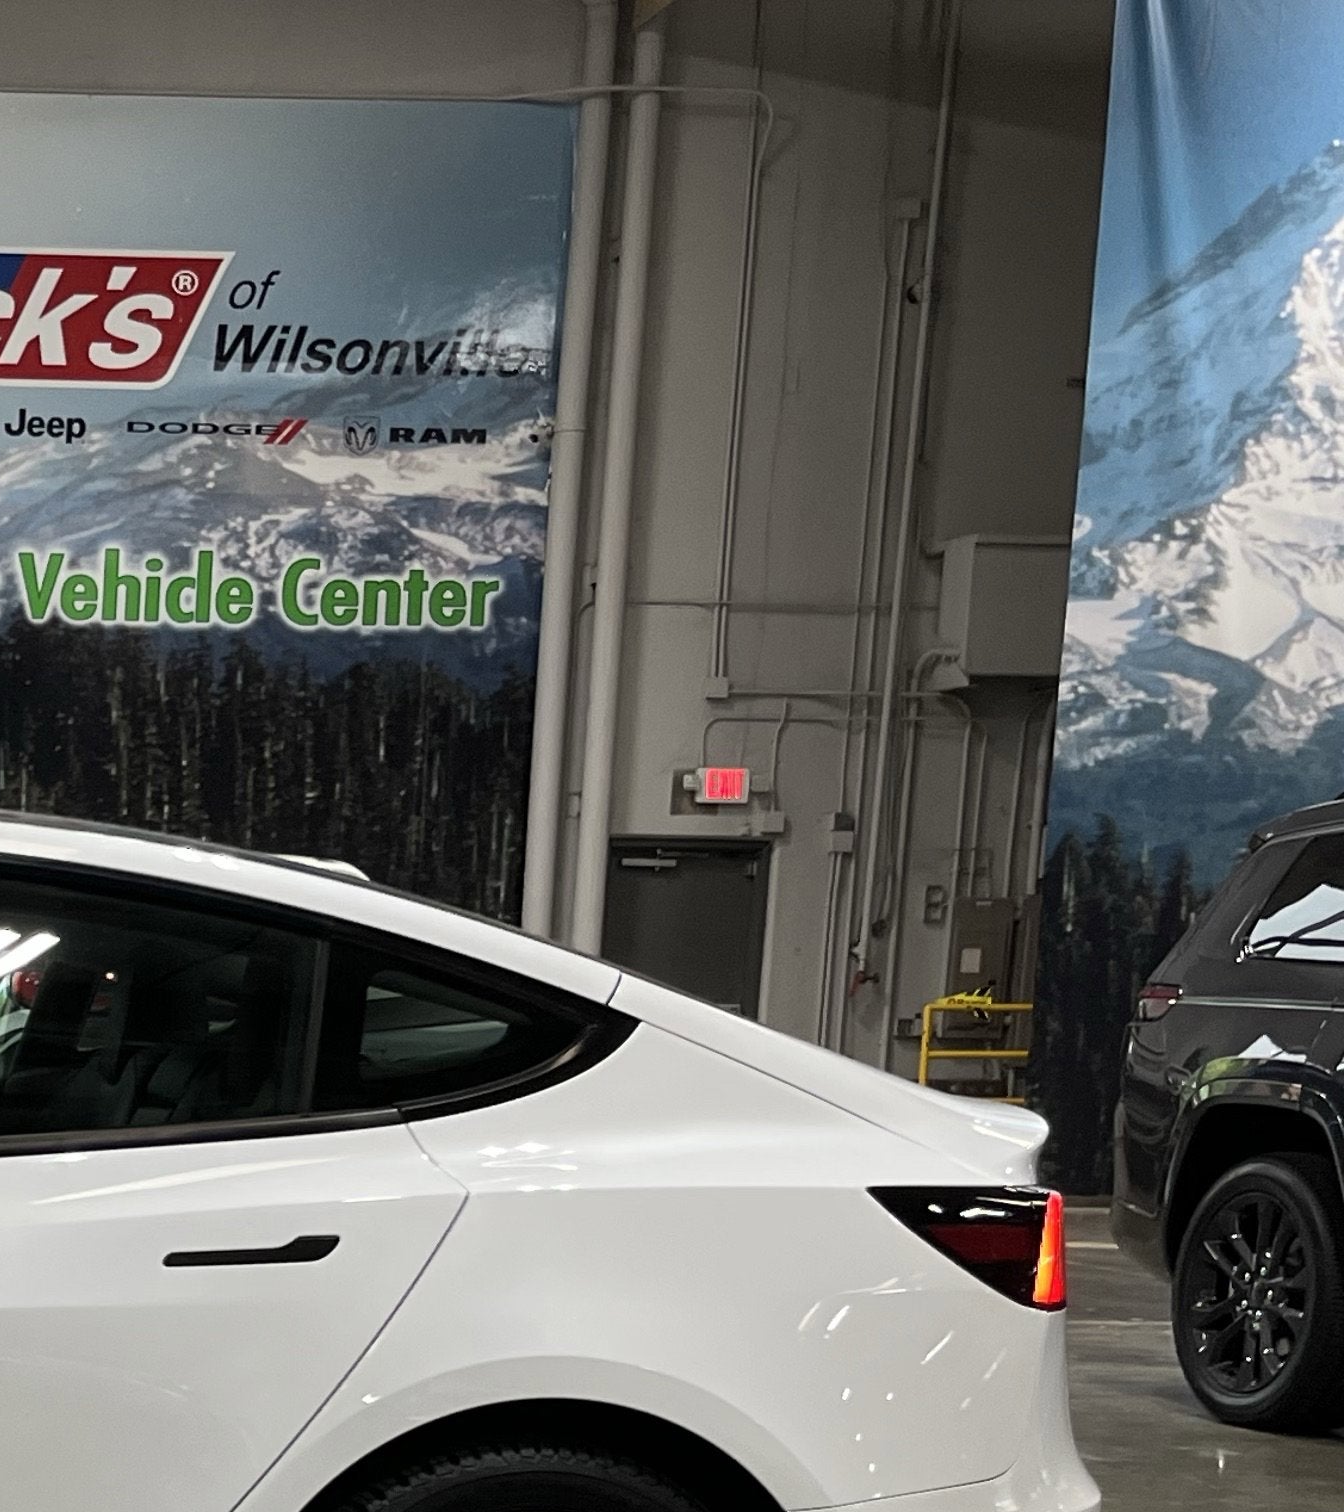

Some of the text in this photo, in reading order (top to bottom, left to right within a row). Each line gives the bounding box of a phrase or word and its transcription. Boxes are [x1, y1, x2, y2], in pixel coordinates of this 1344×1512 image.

[228, 271, 281, 310] of
[4, 408, 86, 444] Jeep
[126, 421, 280, 436] DODGE
[389, 426, 486, 444] RAM
[18, 548, 254, 624] Vehicle
[282, 559, 500, 627] Center
